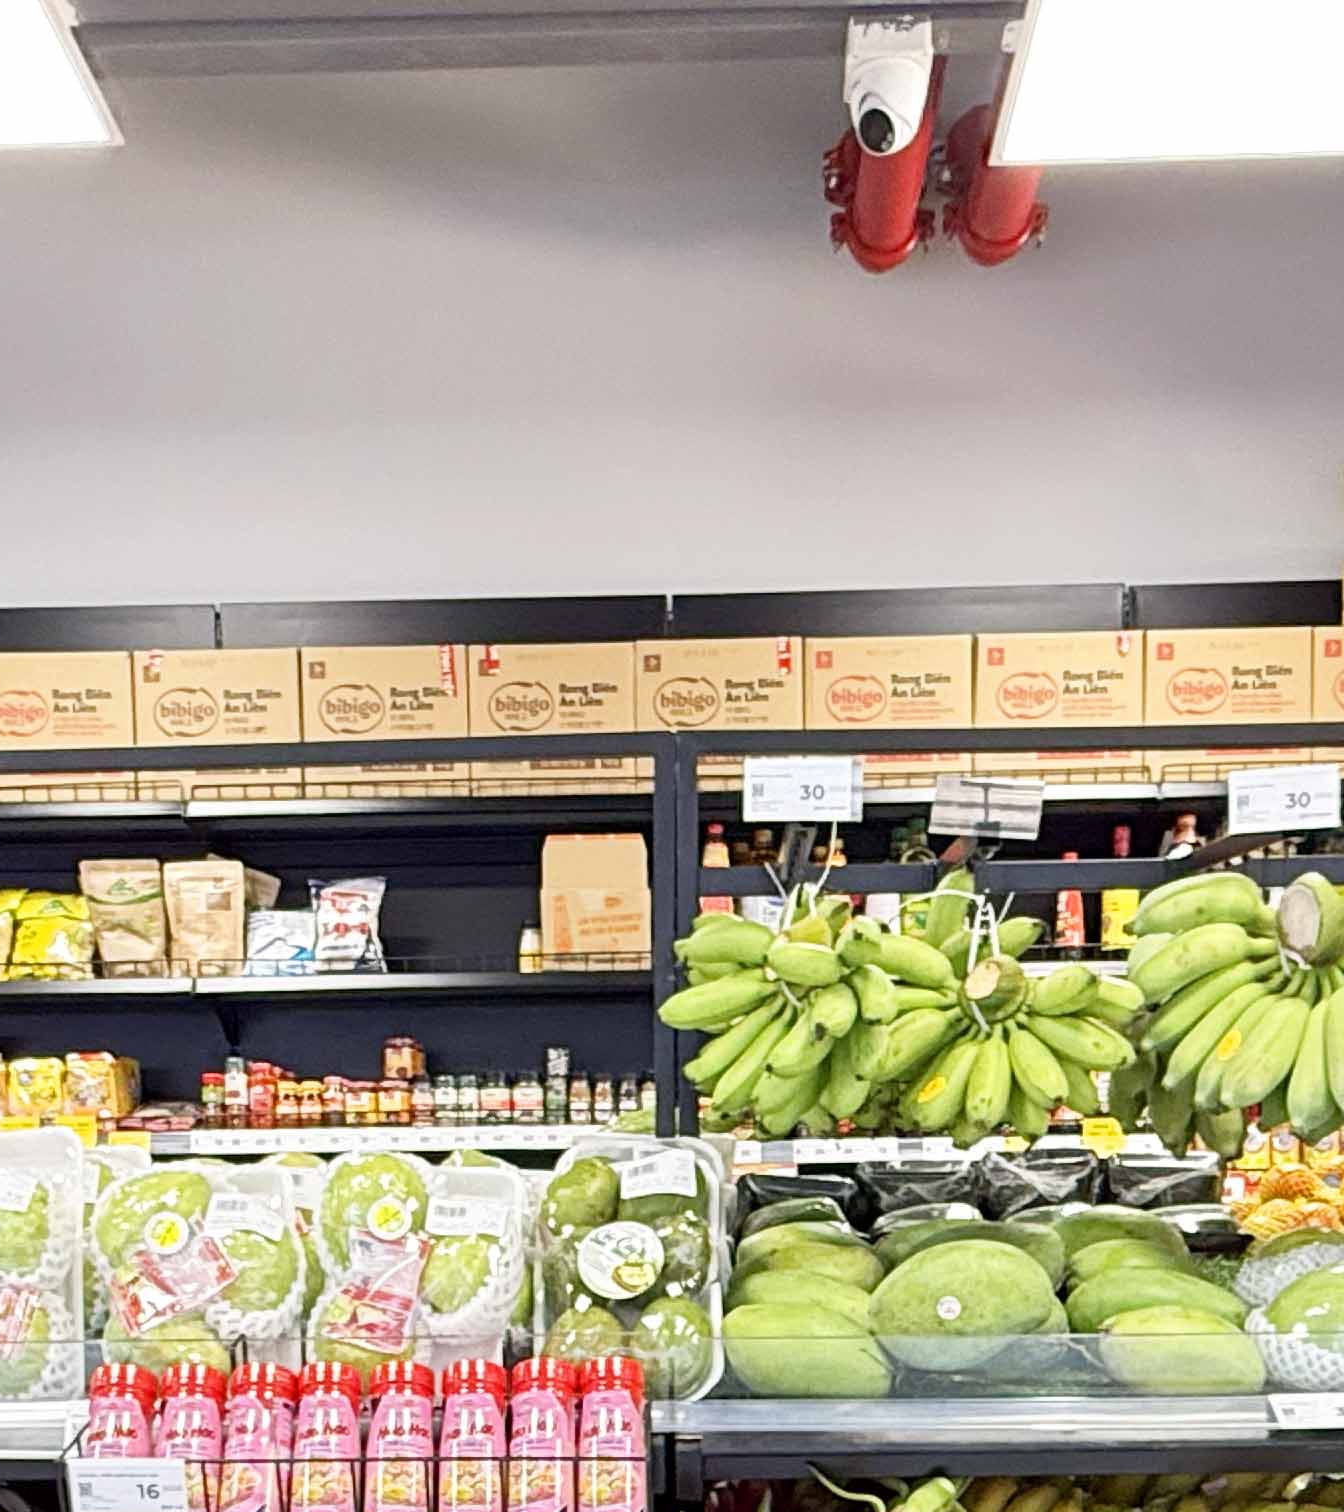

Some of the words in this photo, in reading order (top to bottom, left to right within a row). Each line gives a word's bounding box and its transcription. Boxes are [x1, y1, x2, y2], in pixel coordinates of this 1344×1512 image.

[830, 686, 882, 706] bibigo
[1003, 685, 1055, 705] bibigo
[1172, 680, 1224, 700] bibigo
[325, 697, 380, 719] bibigo
[495, 694, 550, 717] bibigo
[660, 689, 716, 712] bibigo
[160, 701, 215, 722] bibigo
[799, 784, 825, 800] 30
[1284, 792, 1311, 808] 30
[136, 1484, 161, 1500] 16
